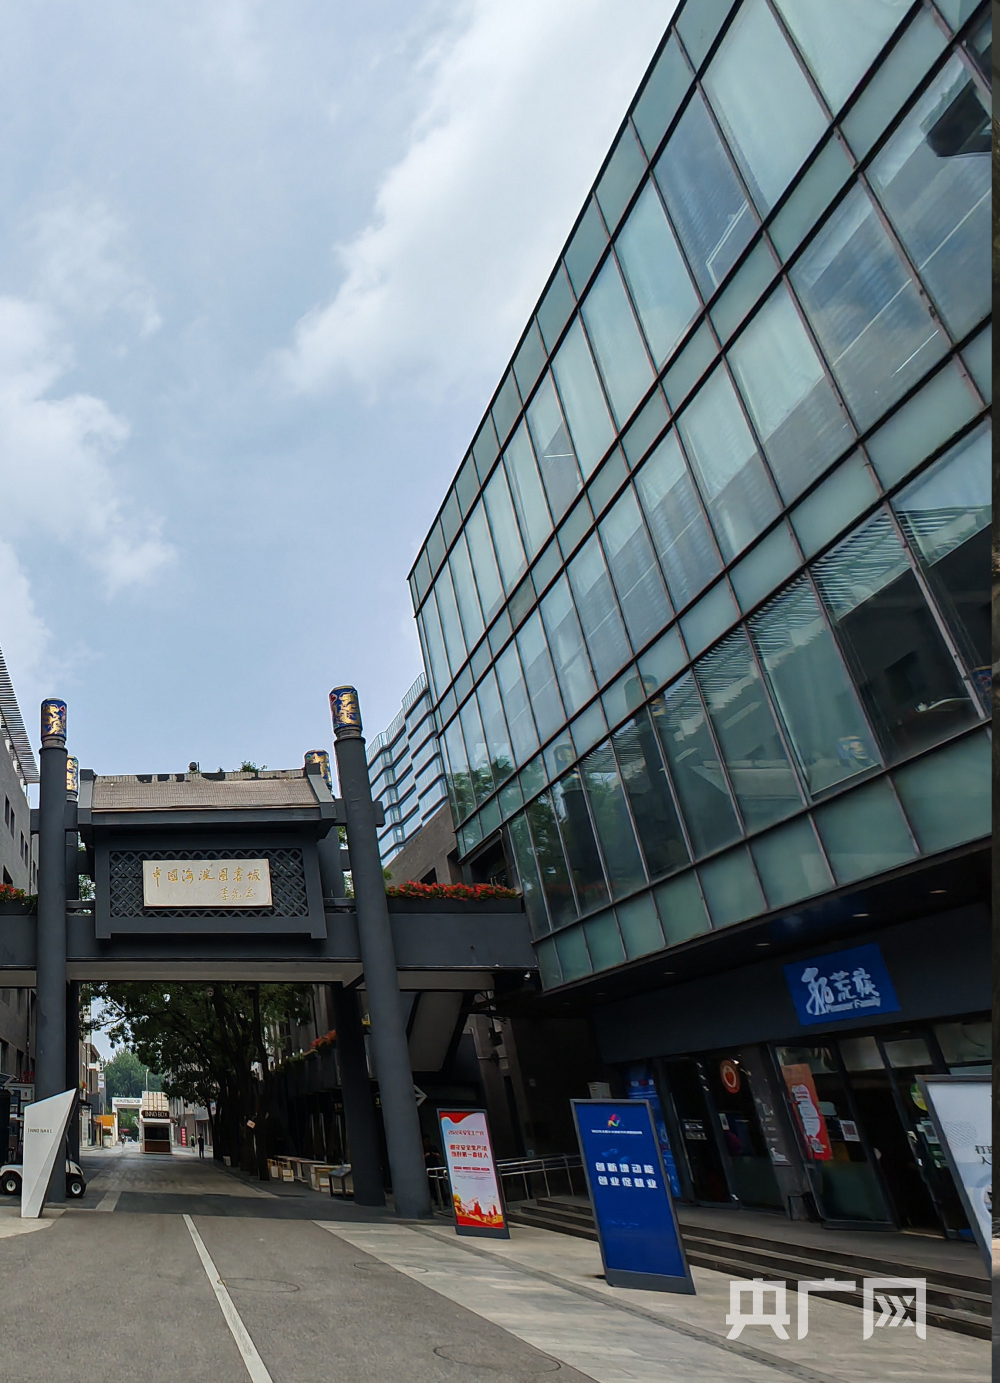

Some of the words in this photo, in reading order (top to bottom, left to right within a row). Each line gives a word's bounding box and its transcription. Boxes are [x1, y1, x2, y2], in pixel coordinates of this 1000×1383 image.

[598, 1175, 658, 1189] 创业促就业
